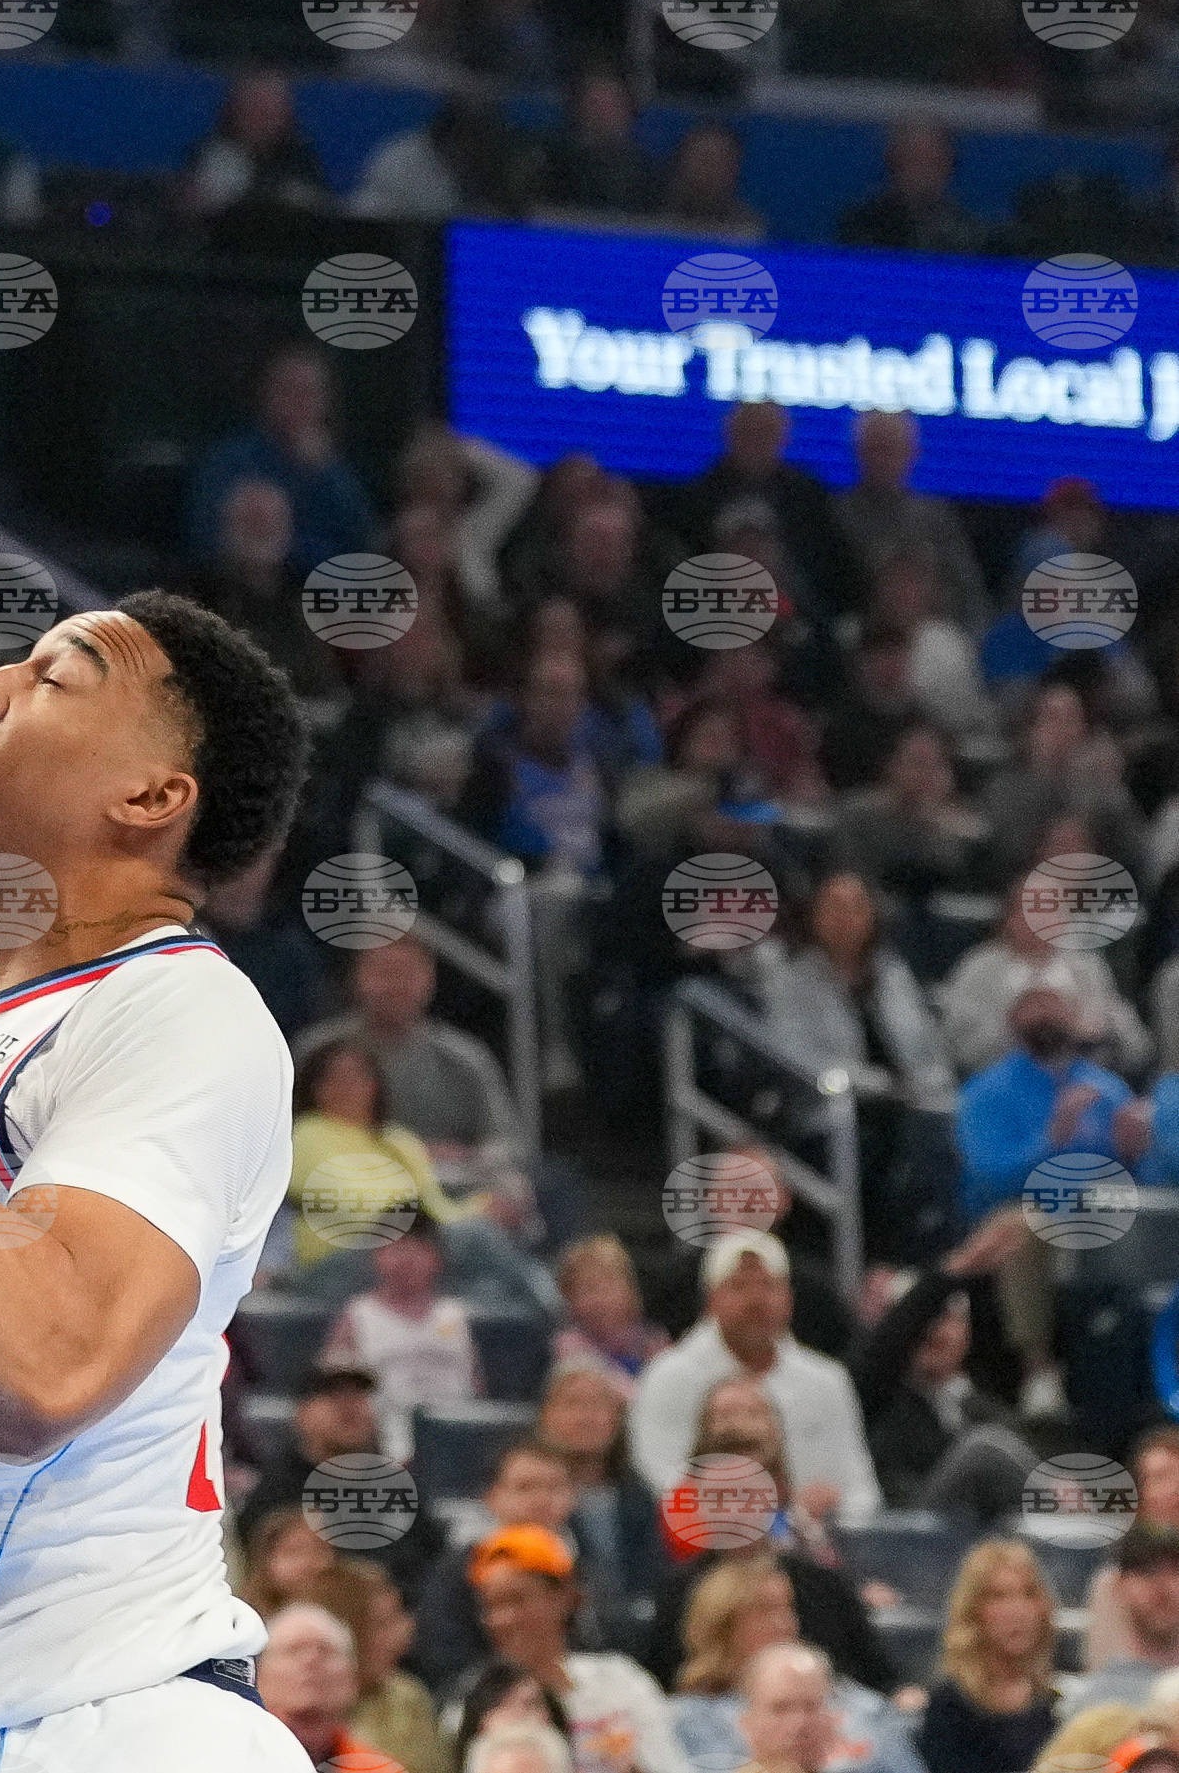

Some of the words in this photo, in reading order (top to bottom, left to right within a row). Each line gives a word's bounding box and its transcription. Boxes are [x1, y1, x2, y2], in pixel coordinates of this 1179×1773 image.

[523, 307, 696, 397] Your
[690, 319, 957, 416] Trusted
[959, 337, 1147, 429] Local
